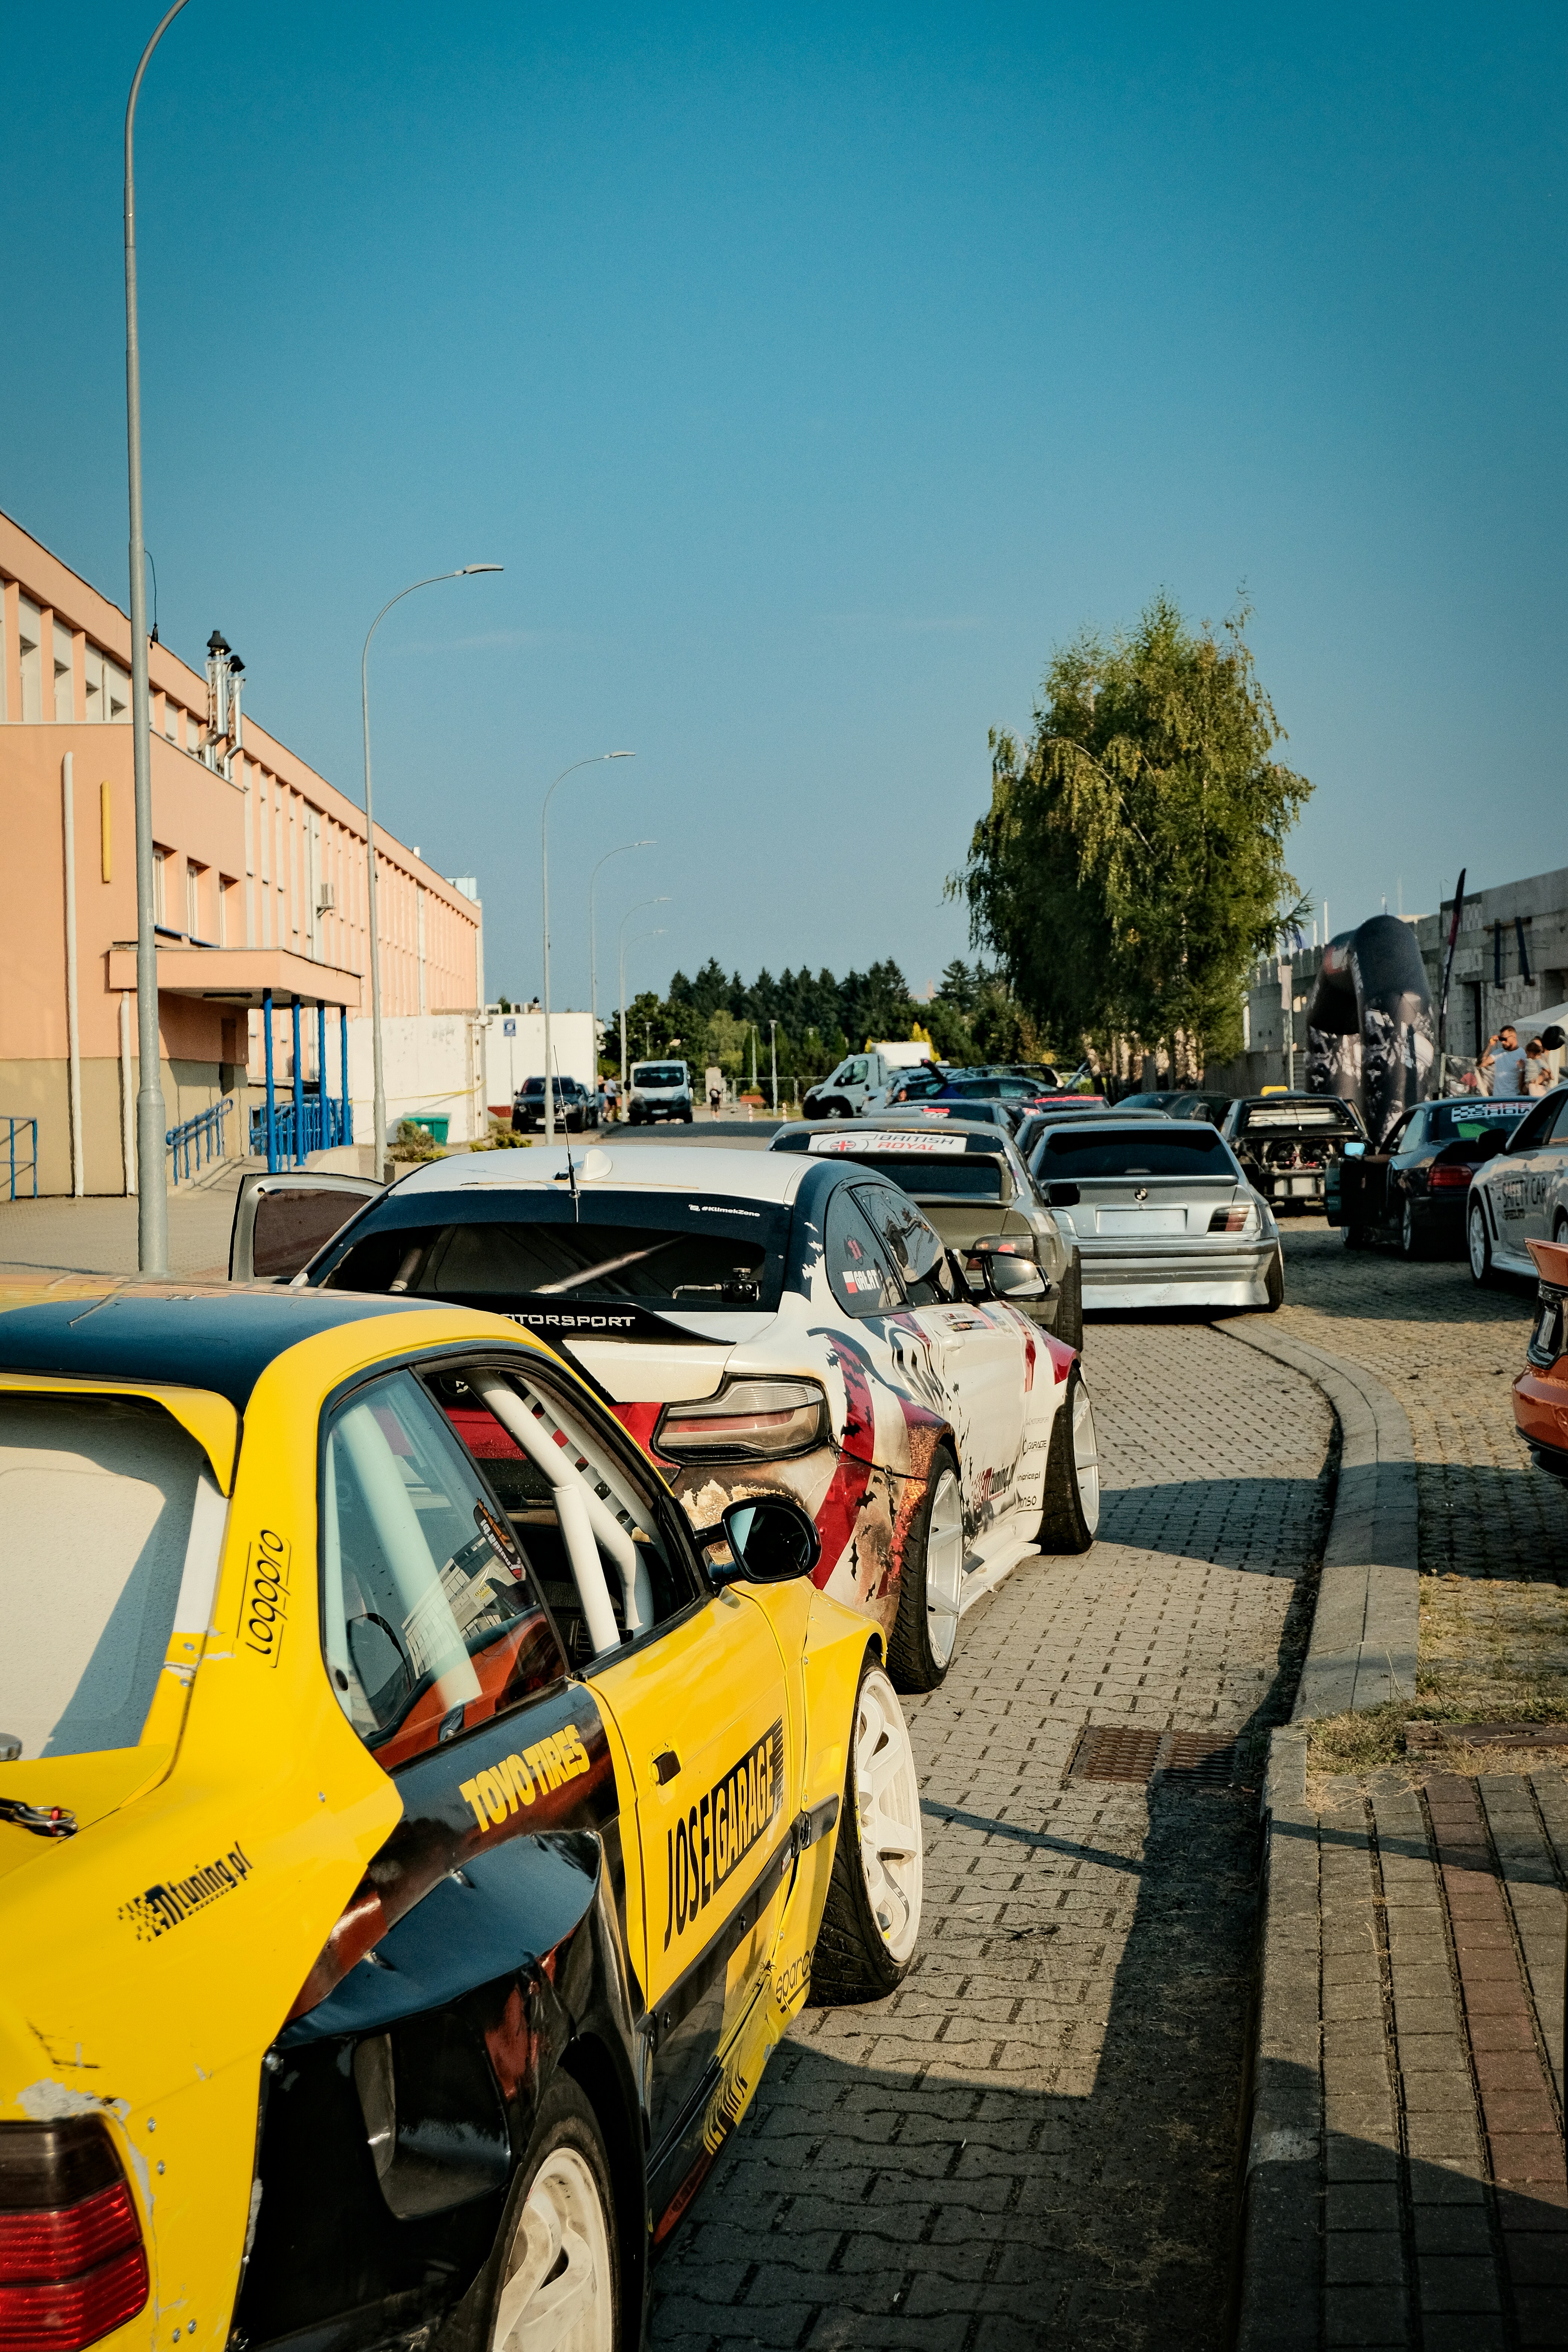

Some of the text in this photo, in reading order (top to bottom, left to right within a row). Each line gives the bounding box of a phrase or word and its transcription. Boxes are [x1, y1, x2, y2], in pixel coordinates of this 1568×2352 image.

[877, 1142, 937, 1151] ROYAL
[879, 1134, 955, 1145] BRITISH
[1531, 1177, 1546, 1205] CAR
[458, 1724, 590, 1833] TOYO TIRES
[664, 1734, 774, 1953] JOSE GARAGE
